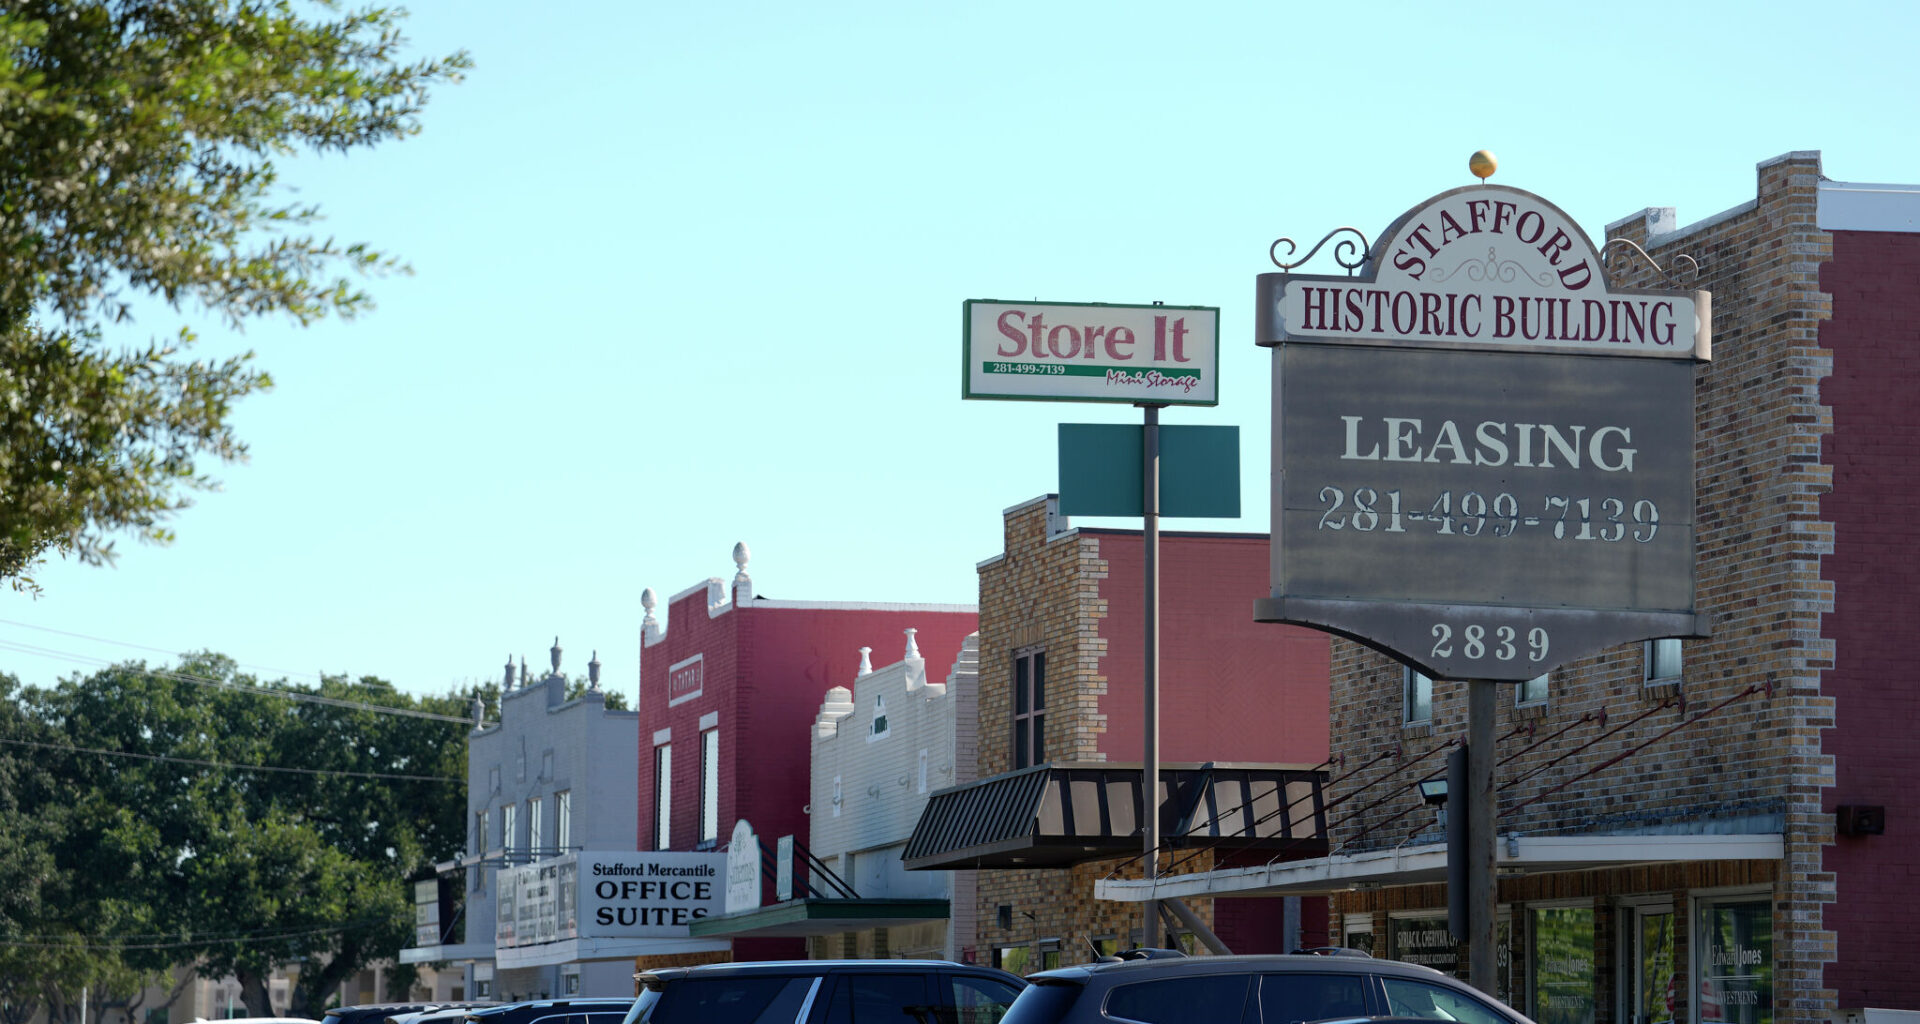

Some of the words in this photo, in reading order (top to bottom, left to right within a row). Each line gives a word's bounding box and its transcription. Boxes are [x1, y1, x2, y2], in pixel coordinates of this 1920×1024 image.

[1393, 199, 1592, 291] STAFFORD
[1301, 286, 1482, 338] HISTORIC
[1492, 295, 1677, 346] BUILDING
[996, 309, 1136, 361] Store
[1153, 315, 1191, 363] It
[993, 362, 1065, 375] 281-499-7139
[1106, 369, 1144, 387] Mini
[1146, 371, 1198, 393] Storage
[1340, 415, 1638, 473] LEASING
[1318, 485, 1660, 543] 281-499-7139
[1430, 623, 1550, 661] 2839
[592, 862, 644, 877] Stafford
[648, 863, 715, 877] Mercantile
[595, 880, 712, 900] OFFICE
[1738, 944, 1762, 968] Jones
